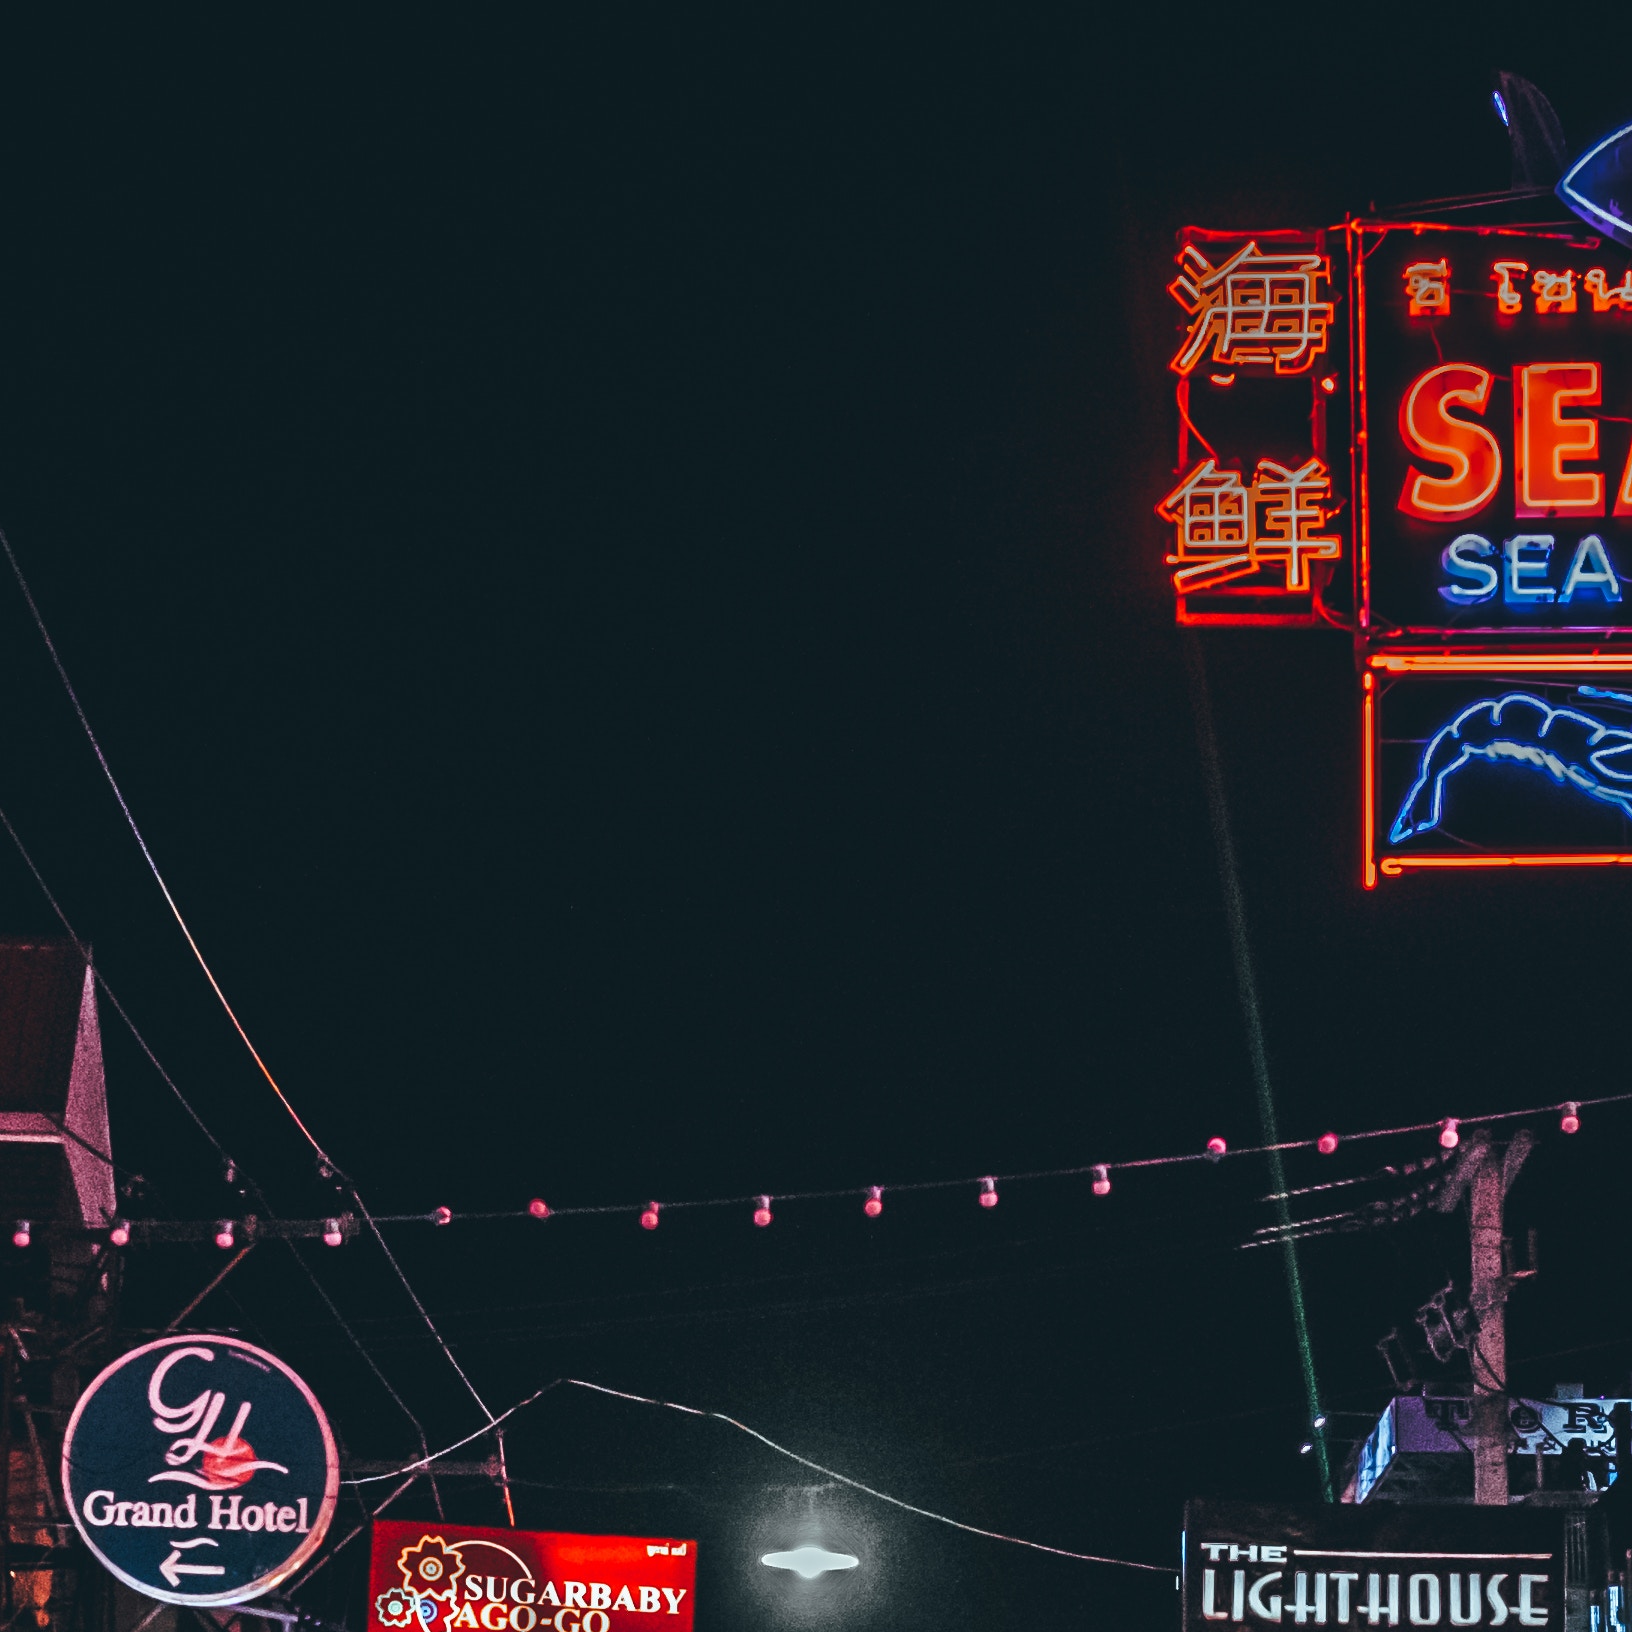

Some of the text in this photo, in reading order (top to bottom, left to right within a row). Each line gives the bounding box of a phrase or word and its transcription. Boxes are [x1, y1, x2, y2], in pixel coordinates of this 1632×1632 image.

[1439, 532, 1622, 603] SEA
[83, 1489, 312, 1534] Grand Hotel
[1201, 1542, 1288, 1563] THE
[464, 1573, 687, 1616] SUGARBABY
[1202, 1568, 1549, 1627] LIGHTHOUSE
